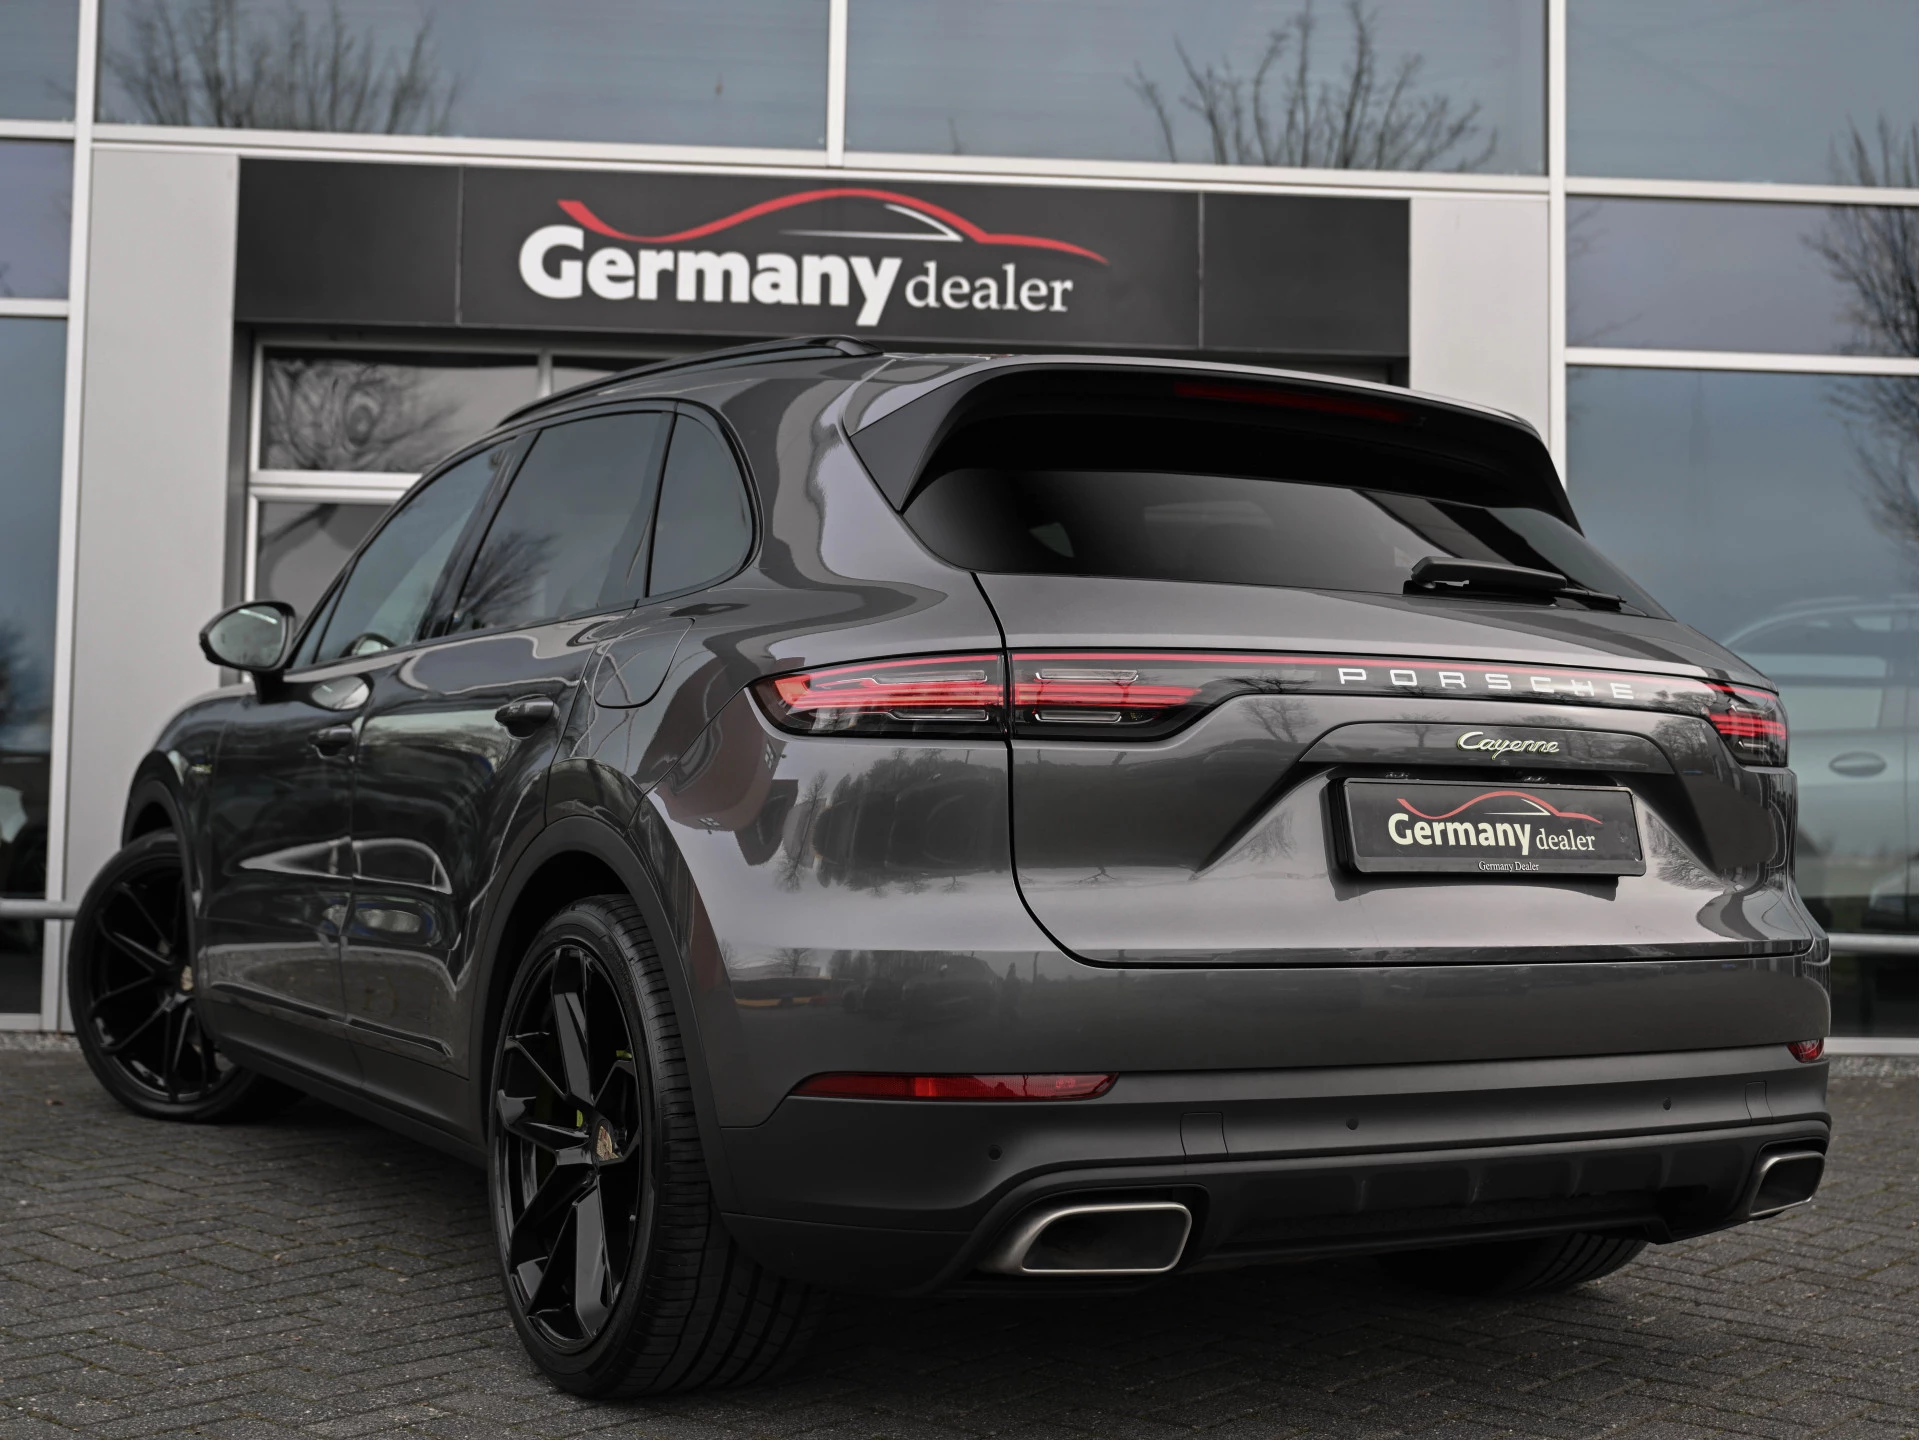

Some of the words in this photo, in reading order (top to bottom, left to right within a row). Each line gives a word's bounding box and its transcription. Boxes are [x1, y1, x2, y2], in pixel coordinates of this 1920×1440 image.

[519, 224, 902, 326] Germany
[904, 261, 1073, 312] dealer
[1338, 667, 1635, 700] PORSCHE
[1456, 731, 1560, 761] Cayenne
[1388, 813, 1531, 855] Germany
[1536, 829, 1595, 852] dealer
[1478, 860, 1513, 872] Germany
[1514, 861, 1540, 872] Dealer
